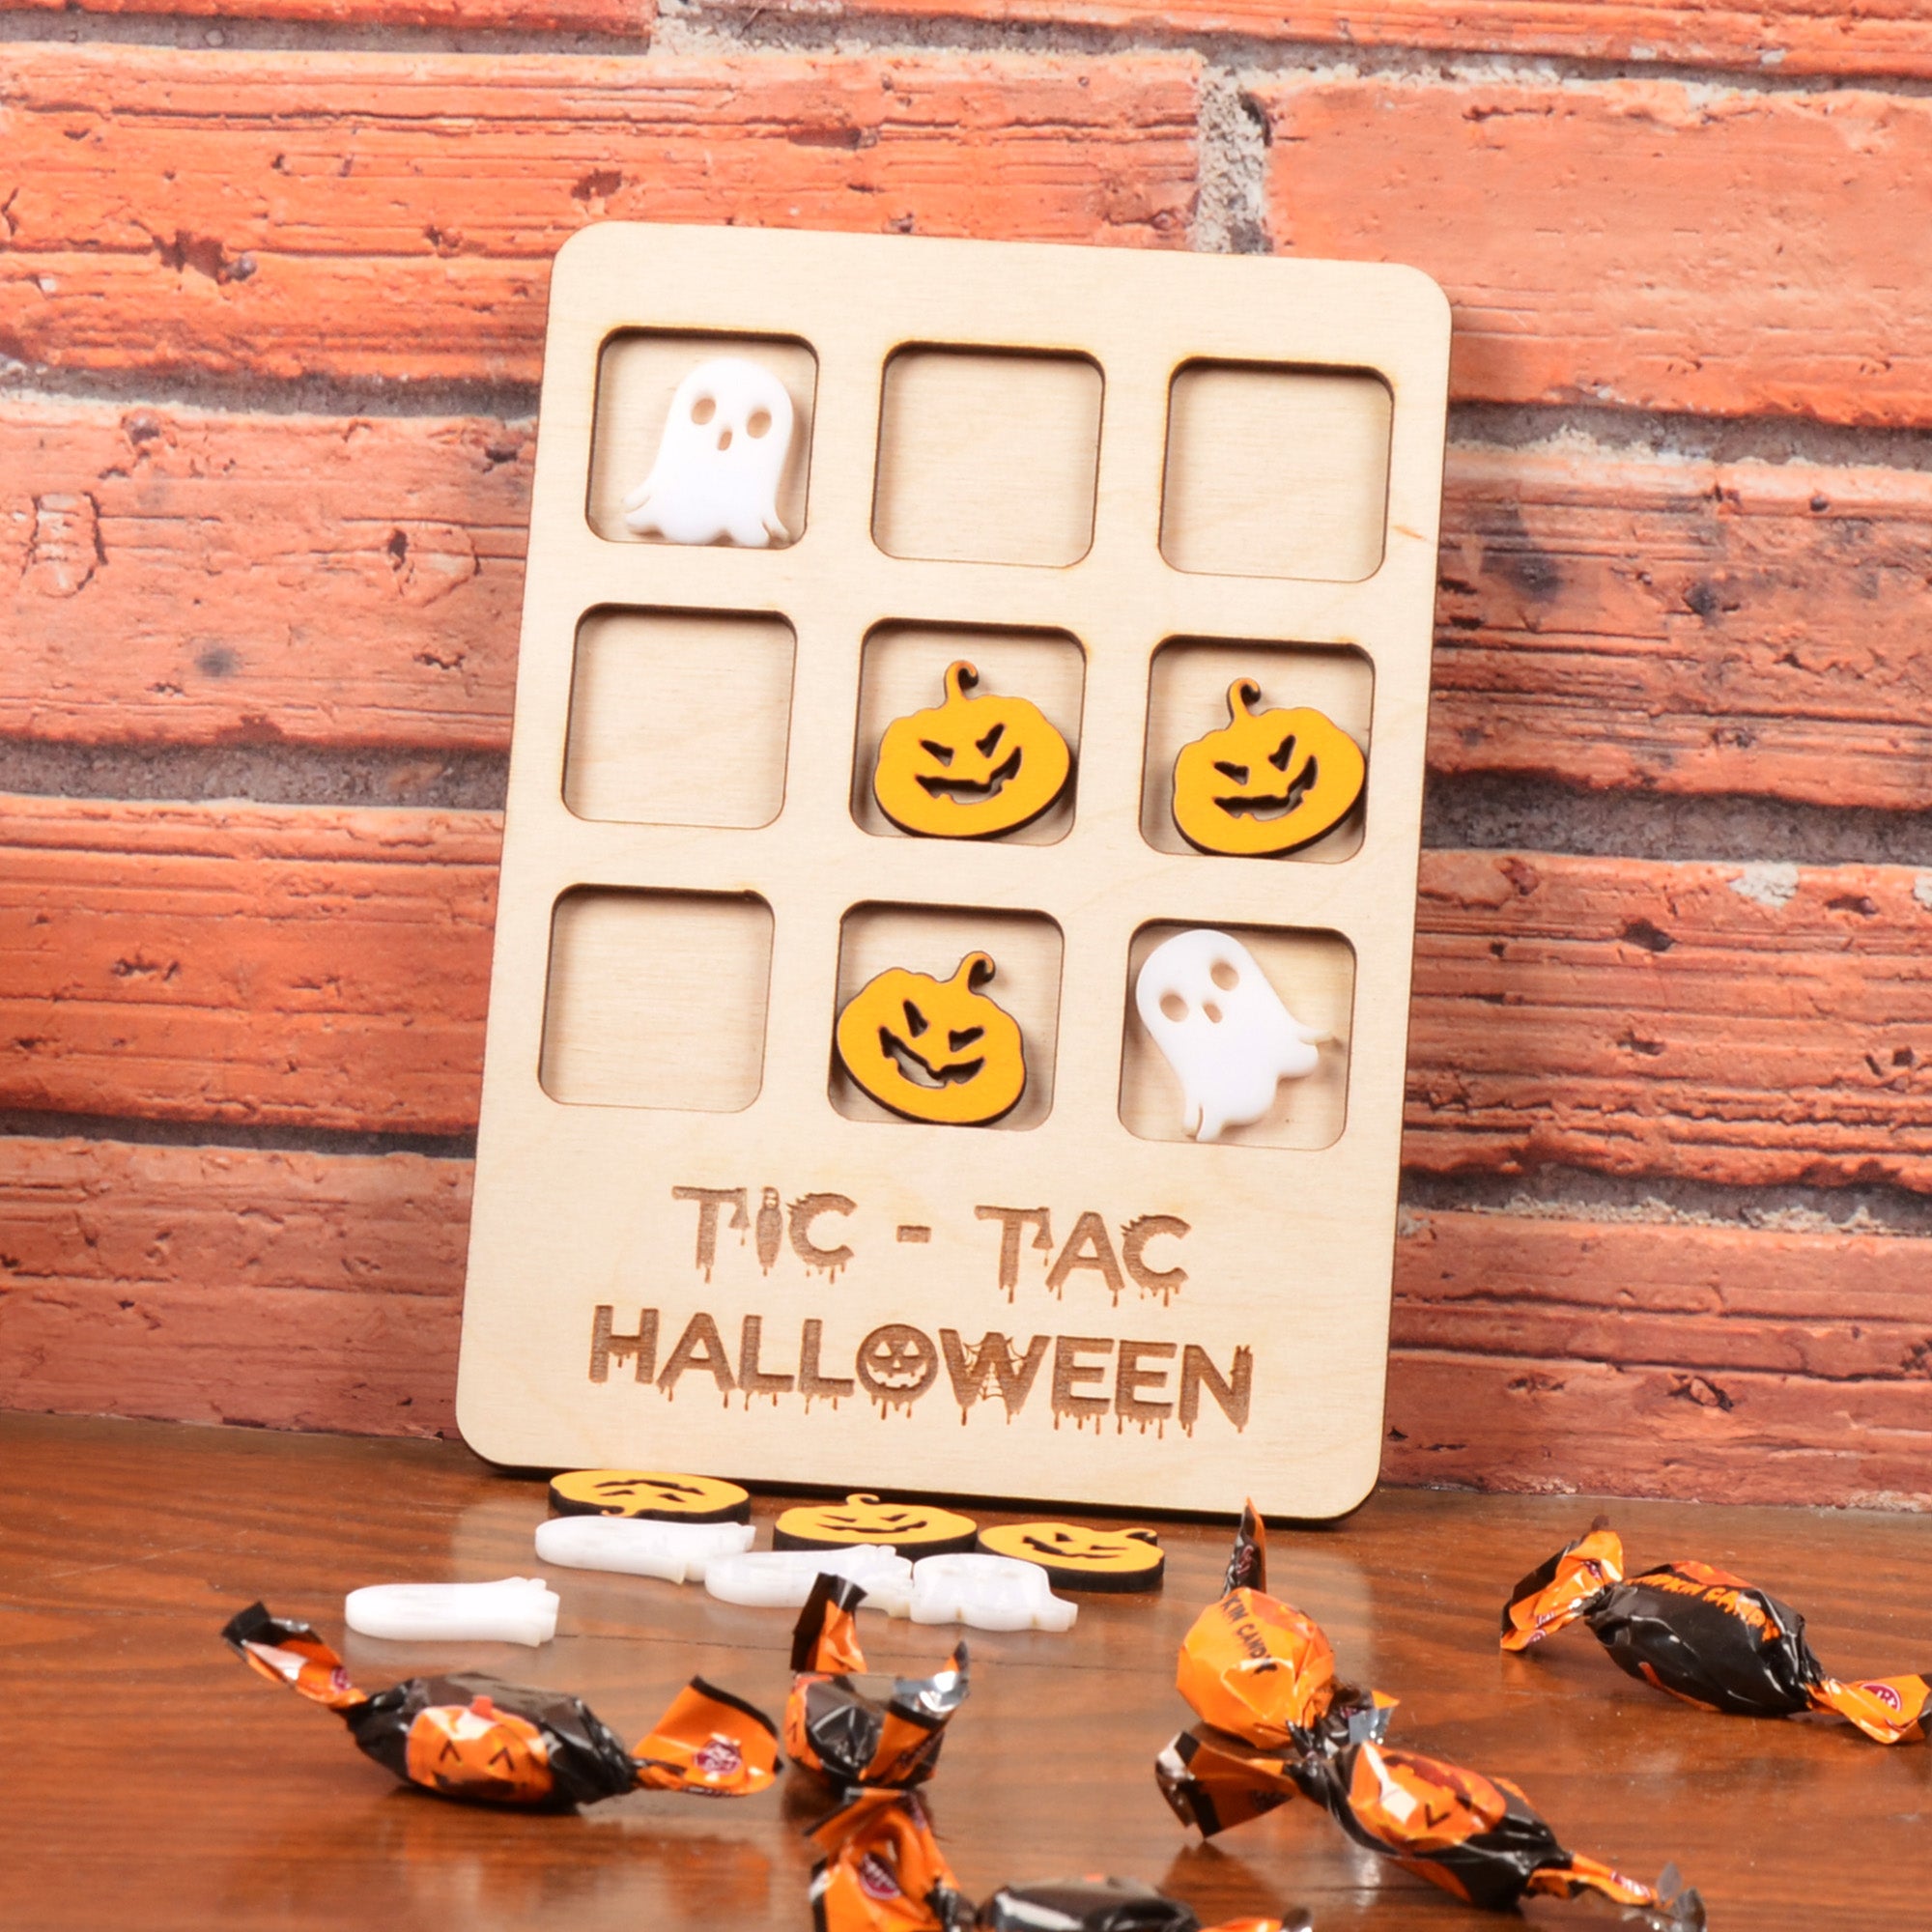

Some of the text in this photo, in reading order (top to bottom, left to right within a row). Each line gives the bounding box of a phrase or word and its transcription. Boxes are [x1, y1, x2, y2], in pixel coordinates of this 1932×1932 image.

[671, 1185, 858, 1283] TIC
[974, 1205, 1192, 1306] TAC
[587, 1304, 1254, 1438] HALLOWEEN
